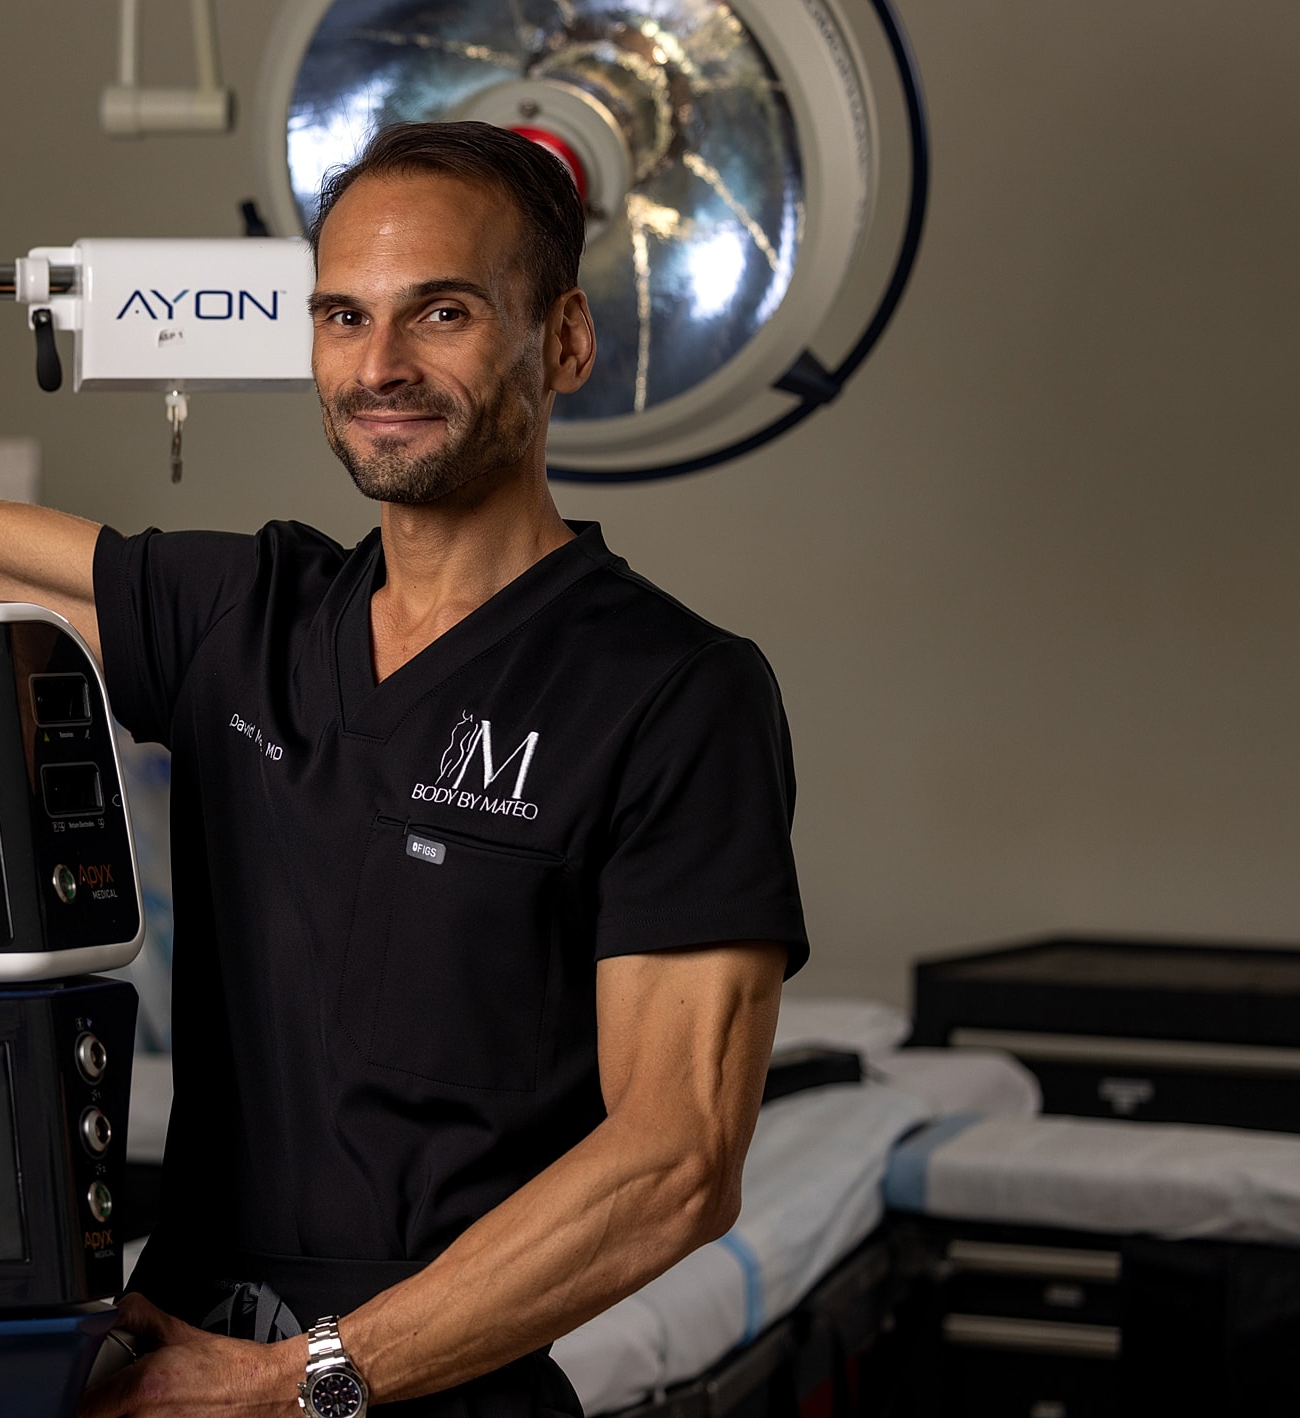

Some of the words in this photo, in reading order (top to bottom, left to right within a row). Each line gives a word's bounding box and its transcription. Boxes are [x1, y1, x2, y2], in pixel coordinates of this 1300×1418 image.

[116, 289, 278, 321] AYON
[229, 713, 256, 738] David
[265, 742, 283, 760] MD
[452, 720, 540, 799] M
[411, 783, 459, 805] BODY
[457, 791, 482, 810] BY
[479, 796, 539, 820] MATEO
[417, 843, 437, 857] FIGS
[79, 864, 114, 889] Apyx
[92, 889, 118, 900] MEDICAL
[84, 1229, 113, 1250] Apyx
